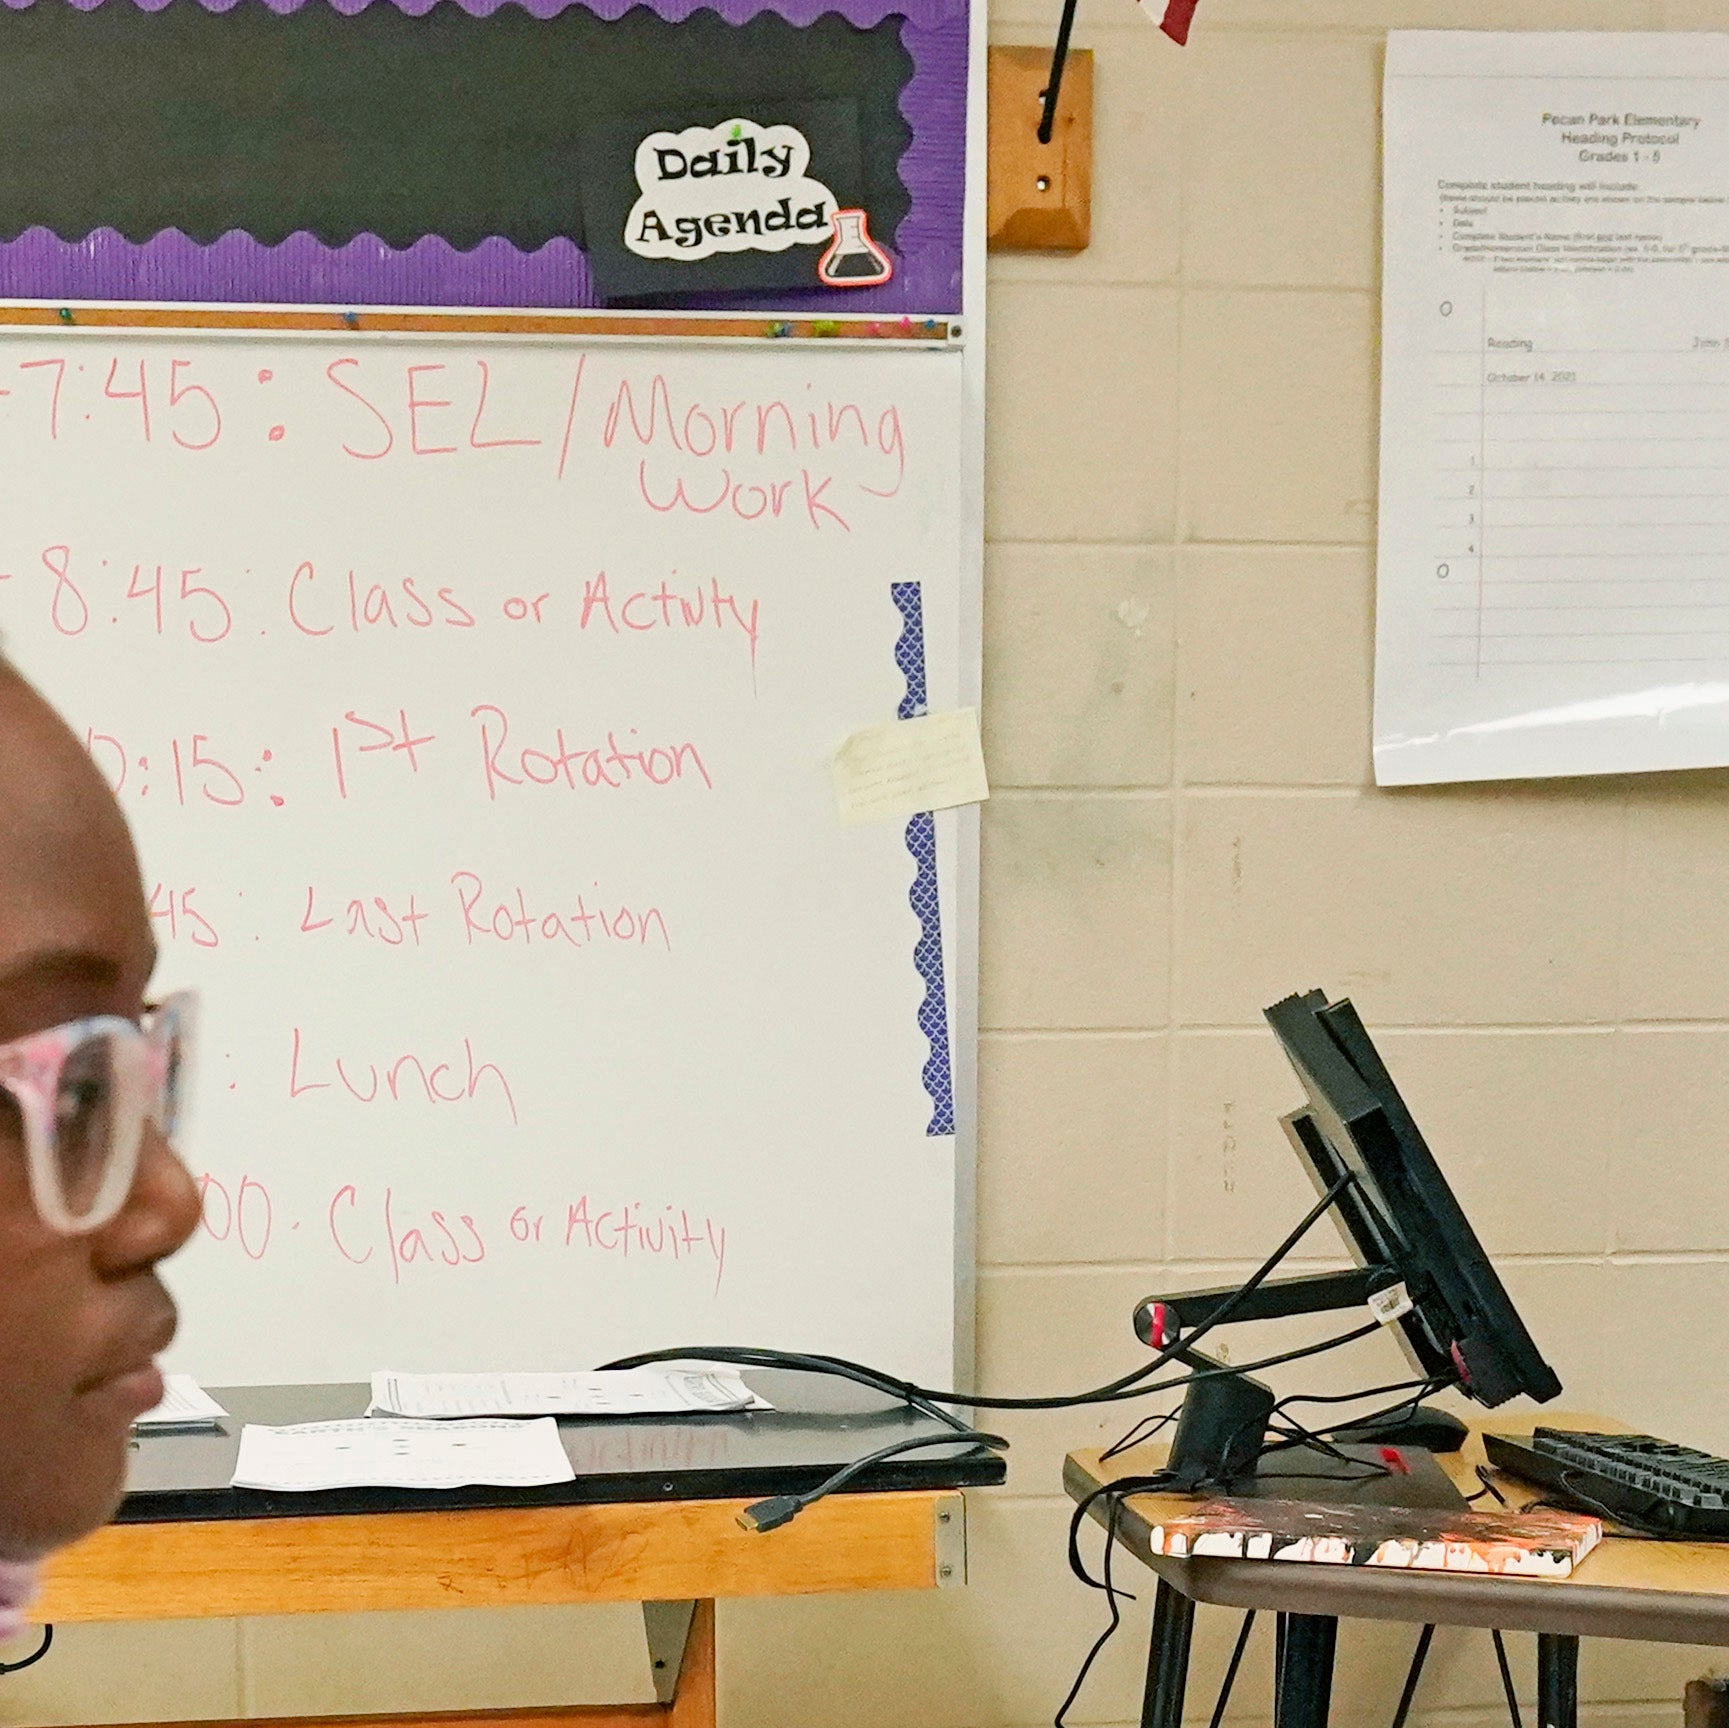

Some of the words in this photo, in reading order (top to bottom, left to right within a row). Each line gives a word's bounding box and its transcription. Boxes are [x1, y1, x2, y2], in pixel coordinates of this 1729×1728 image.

[1541, 112, 1584, 127] Pecan
[1588, 112, 1620, 126] Park
[1624, 113, 1701, 130] Elementary
[1561, 131, 1618, 147] Heading
[1622, 131, 1680, 145] Protocol
[652, 136, 796, 182] Daily
[1578, 150, 1629, 163] Grades
[635, 196, 830, 248] Agenda
[1487, 337, 1534, 352] Reading
[1487, 371, 1531, 383] October
[1551, 371, 1577, 383] 2021
[639, 459, 852, 532] Work
[288, 560, 475, 636] Class
[503, 596, 549, 623] or
[470, 704, 713, 800] Rotation
[300, 885, 431, 947] Last
[451, 870, 671, 952] Rotation
[288, 1027, 519, 1126] Lunch
[330, 1184, 486, 1285] Class
[565, 1196, 726, 1298] Activity
